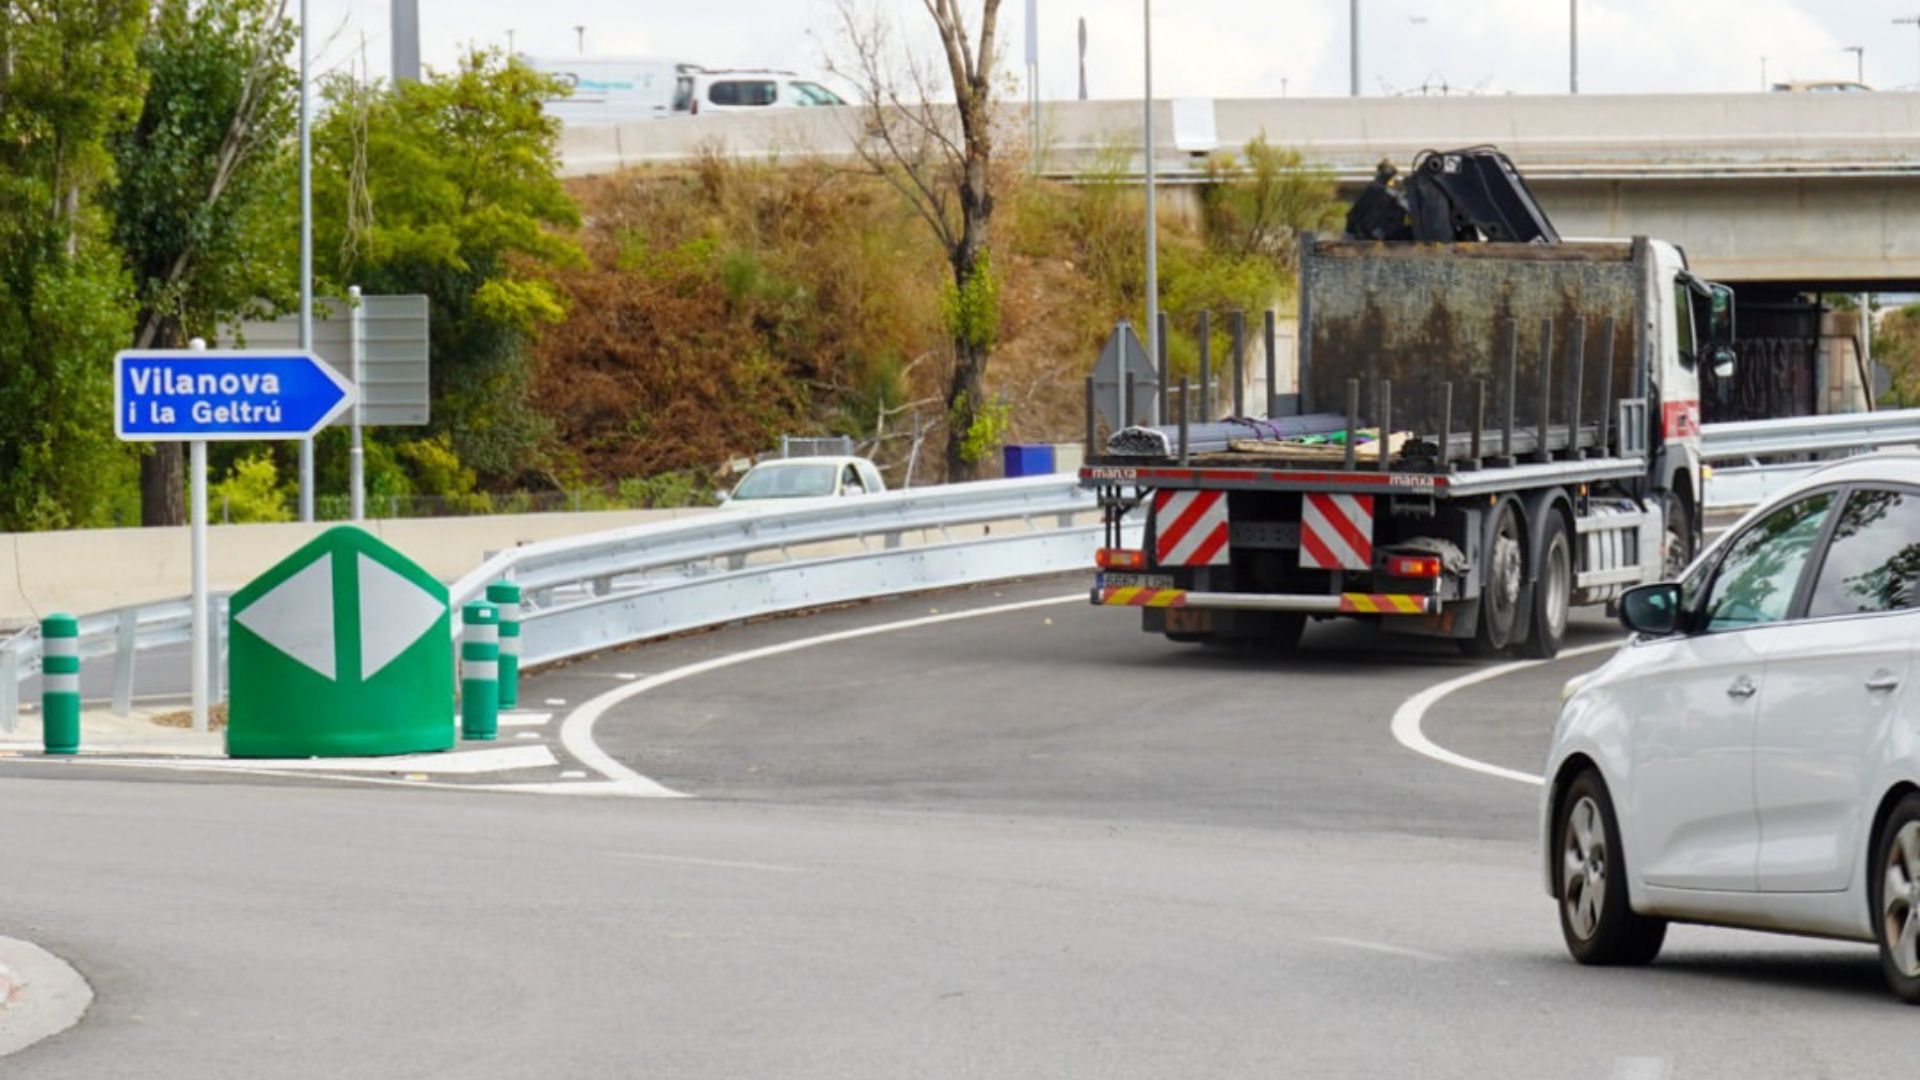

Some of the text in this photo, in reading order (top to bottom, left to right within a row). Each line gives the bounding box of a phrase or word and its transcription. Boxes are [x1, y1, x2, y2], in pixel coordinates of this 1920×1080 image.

[129, 367, 280, 396] Vilanova
[129, 399, 282, 424] i la Geltrú
